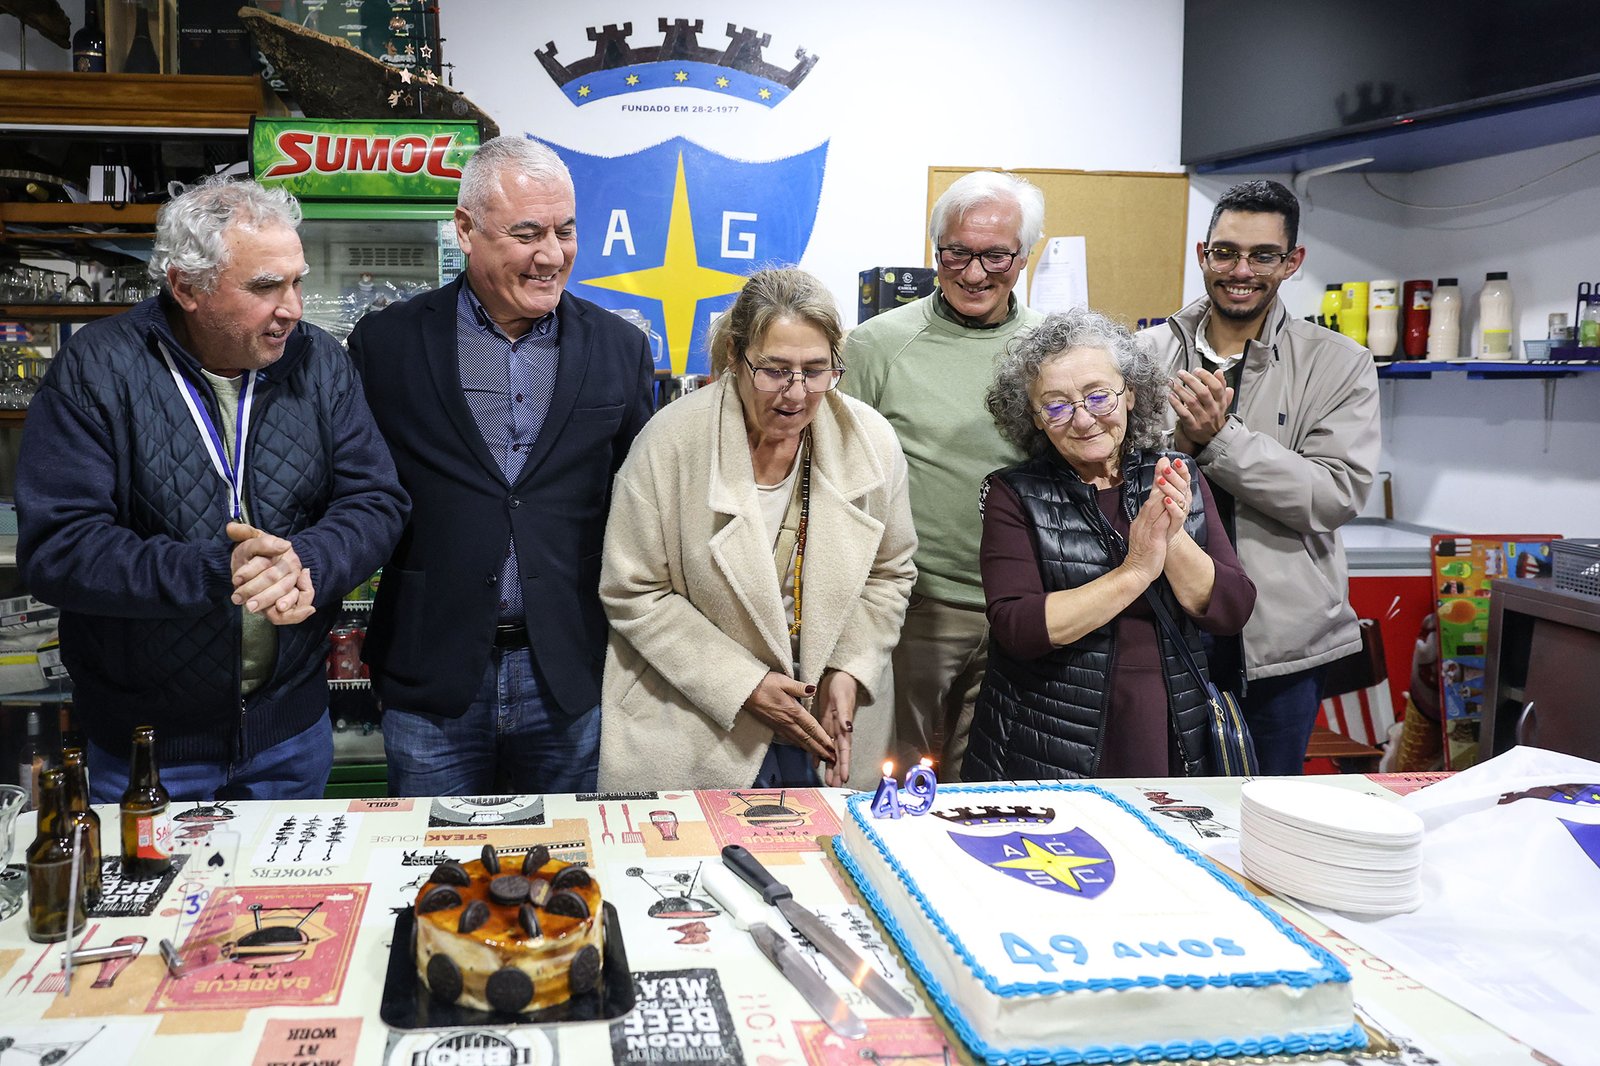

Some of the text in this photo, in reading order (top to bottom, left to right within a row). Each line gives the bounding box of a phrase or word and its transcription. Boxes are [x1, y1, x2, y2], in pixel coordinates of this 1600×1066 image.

[621, 104, 740, 114] FUNDADO EM 28-2-1977
[263, 131, 463, 179] SUMOL
[602, 209, 758, 259] A G
[741, 835, 817, 843] ARBECUE
[250, 865, 339, 879] SMOKERS
[1000, 931, 1247, 973] 49 ANOS
[213, 971, 294, 980] PARTY
[192, 976, 311, 993] BARBECUE
[634, 977, 709, 1000] MEA
[623, 1007, 720, 1035] BEEF
[286, 1027, 337, 1041] WORK
[625, 1032, 722, 1050] BACON
